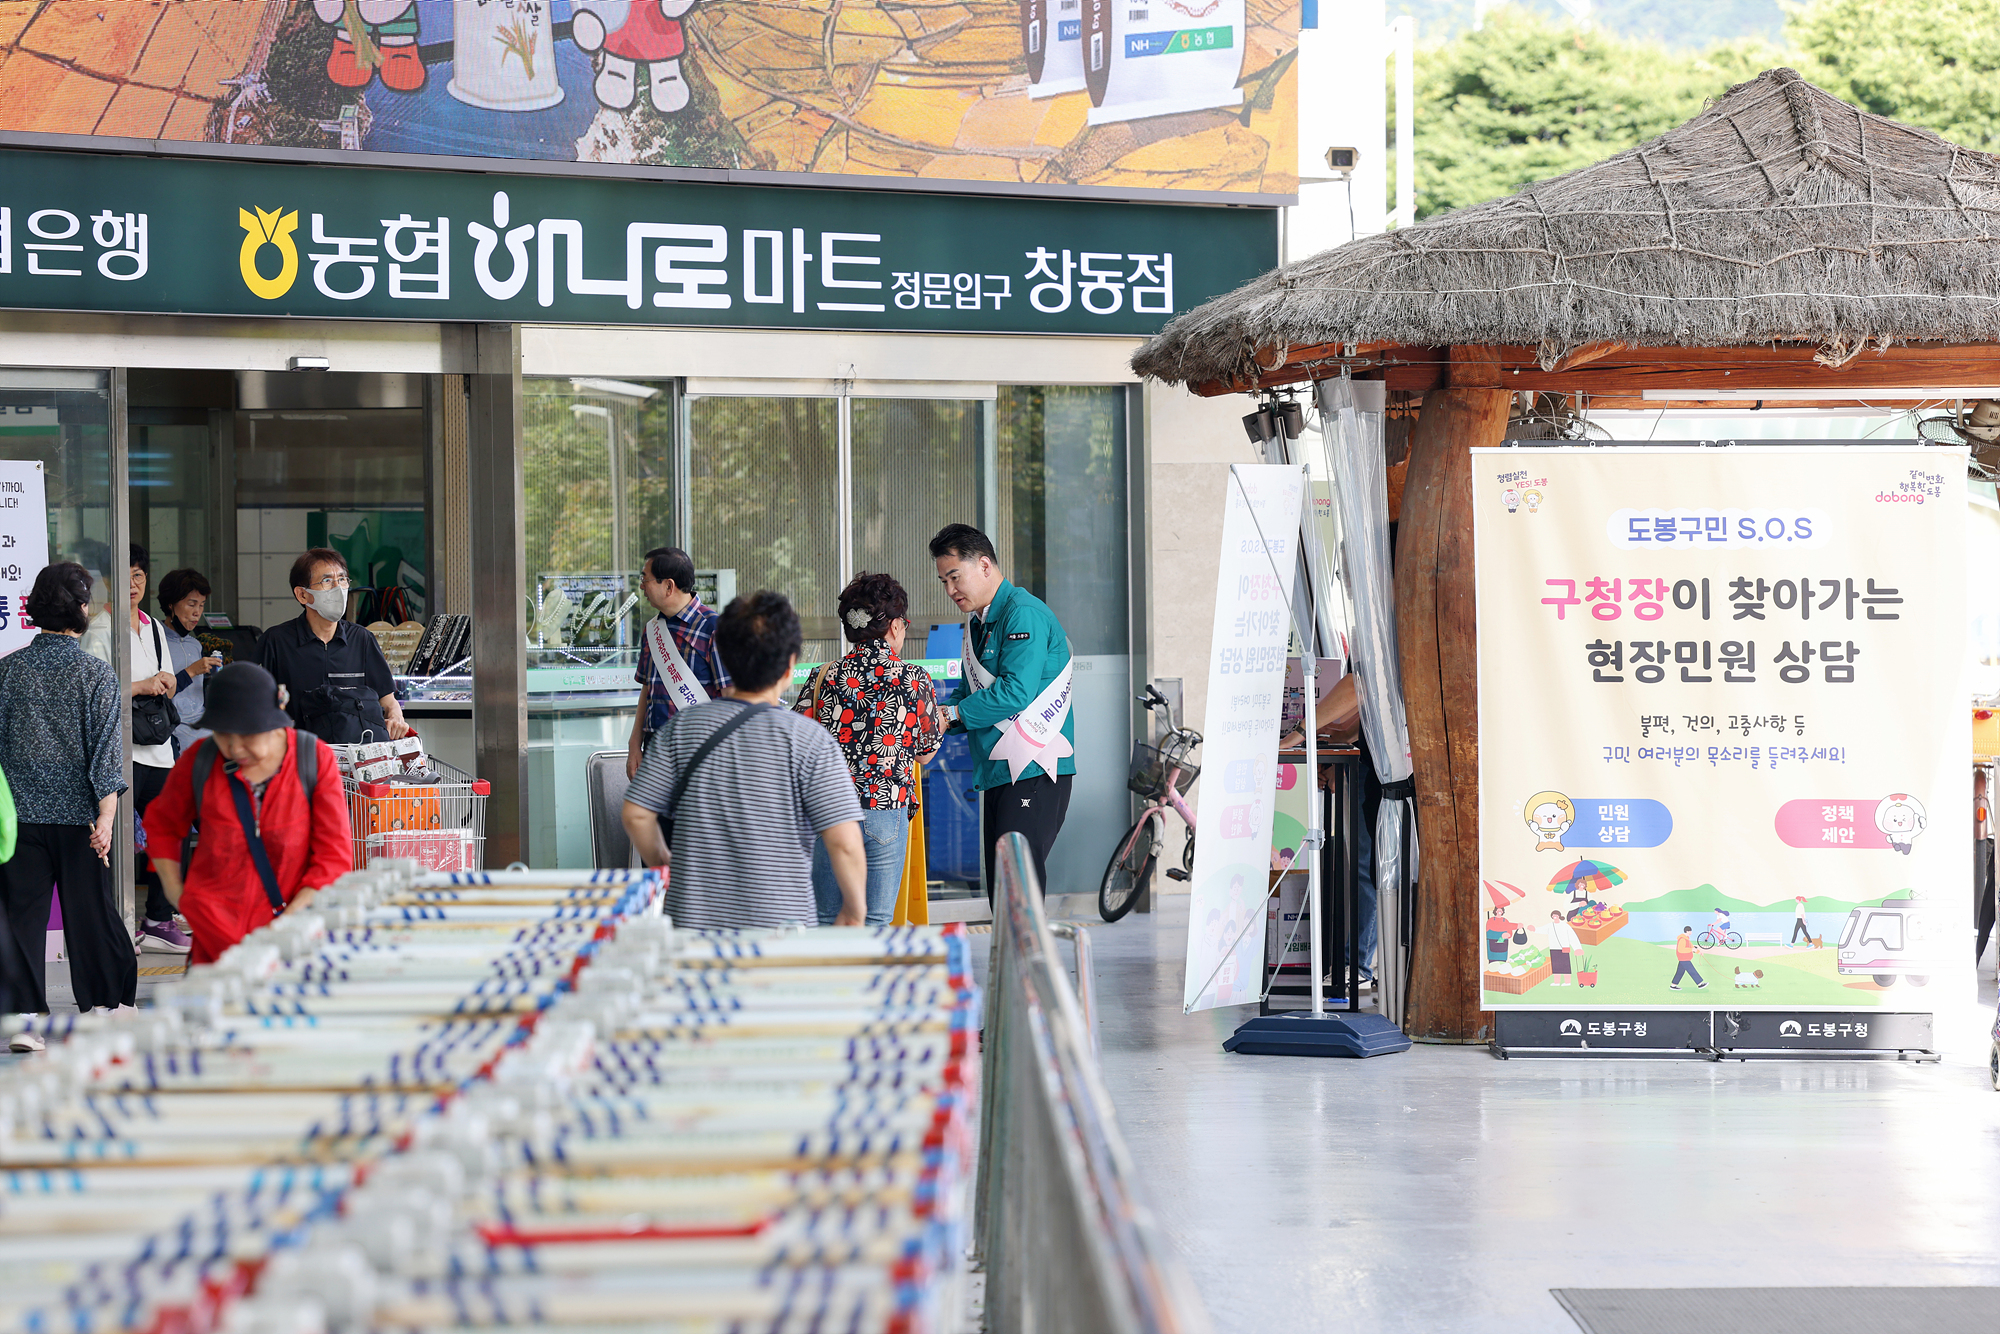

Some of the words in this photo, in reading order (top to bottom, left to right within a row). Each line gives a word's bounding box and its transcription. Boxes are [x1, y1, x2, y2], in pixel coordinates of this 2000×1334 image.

[1064, 25, 1080, 36] NH
[1131, 39, 1149, 51] NH
[308, 213, 450, 300] 농협
[468, 190, 885, 313] 하나로마트
[891, 271, 1011, 310] 정문입구
[1024, 246, 1173, 314] 창동점
[1497, 470, 1527, 483] 청렴실천
[1515, 480, 1532, 489] YES!
[1533, 478, 1548, 487] 도봉
[1909, 470, 1925, 480] 같이
[1875, 491, 1924, 505] dobong
[1899, 481, 1926, 493] 행복한
[1926, 486, 1941, 498] 도봉
[1628, 516, 1728, 543] 도봉구민
[1738, 516, 1813, 542] S.O.S
[1540, 576, 1711, 621] 구청장이
[1728, 576, 1904, 621] 찾아가는
[1586, 639, 1756, 684] 현장민원
[1773, 639, 1861, 684] 상담
[1640, 714, 1675, 736] 불편,
[1682, 714, 1721, 736] 건의,
[1728, 714, 1787, 737] 고충사항
[1794, 714, 1806, 735] 등
[1602, 746, 1630, 765] 구민
[1637, 746, 1700, 769] 여러분의
[1708, 746, 1761, 770] 목소리를
[1769, 745, 1846, 770] 들려주세요!
[1598, 804, 1630, 821] 민원
[1821, 805, 1855, 822] 정책
[1597, 826, 1631, 843] 상담
[1821, 826, 1856, 844] 제안
[1587, 1020, 1647, 1037] 도봉구청
[1806, 1020, 1869, 1038] 도봉구청
